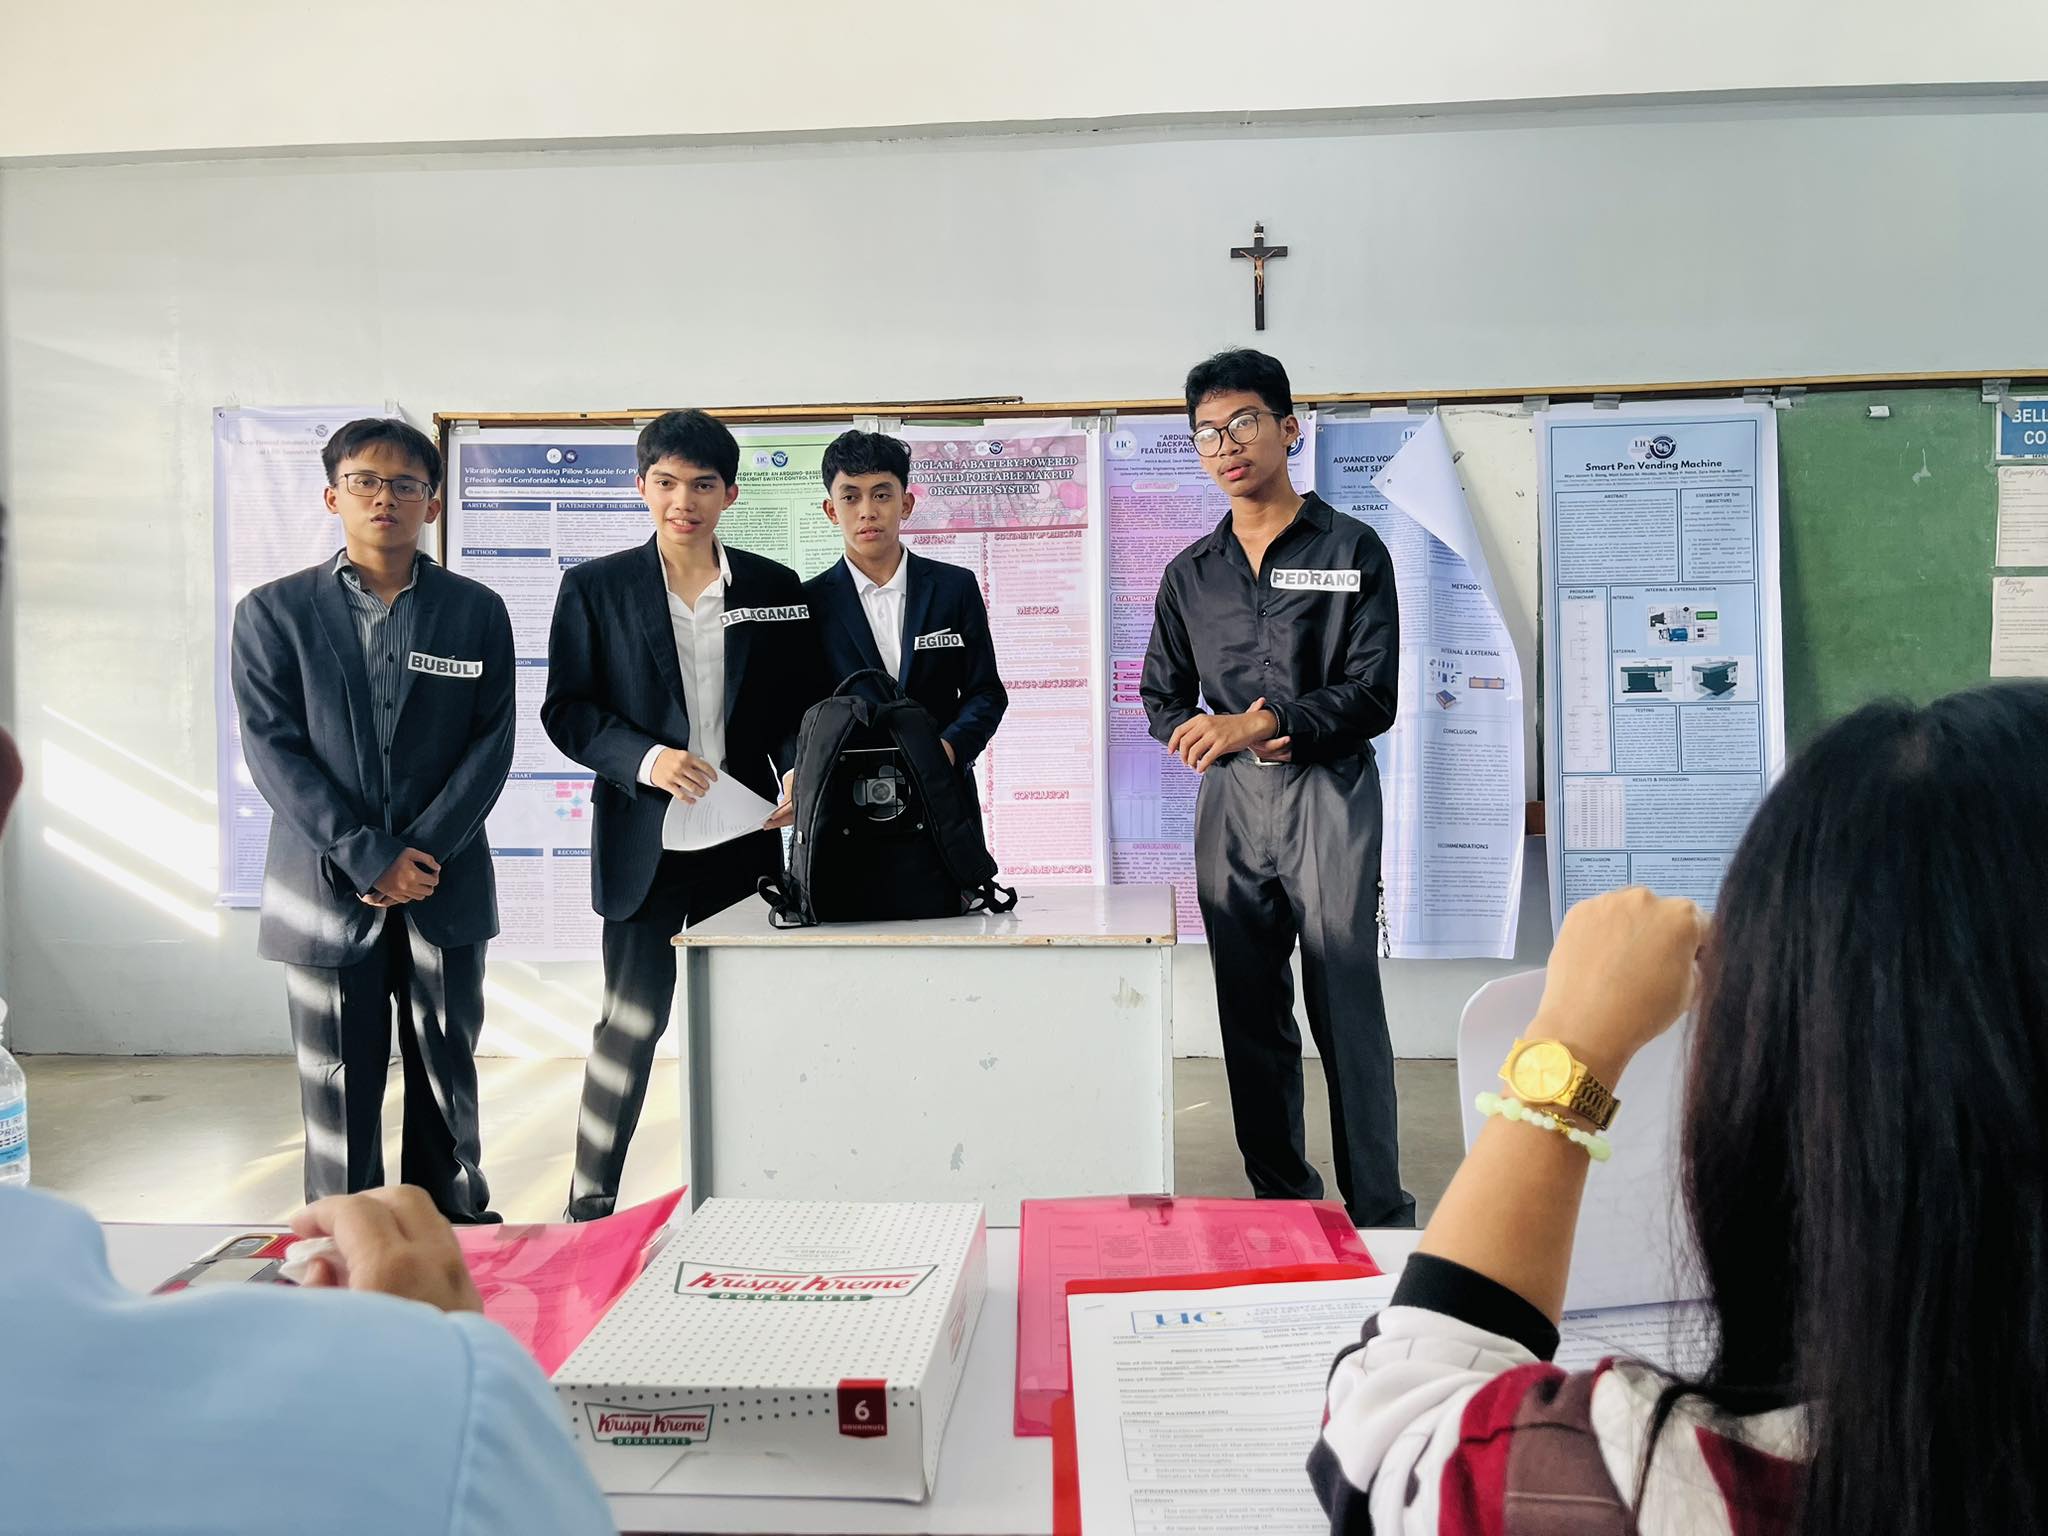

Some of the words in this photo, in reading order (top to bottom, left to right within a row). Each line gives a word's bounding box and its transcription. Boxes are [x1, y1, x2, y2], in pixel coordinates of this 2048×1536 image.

[969, 456, 1078, 469] BATTERY-POWERED
[1333, 455, 1376, 463] ADVANCED
[1585, 462, 1615, 471] Smart
[1617, 462, 1635, 470] Pen
[1637, 461, 1678, 471] Vending
[1681, 459, 1722, 469] Machine
[464, 466, 526, 476] VibratingArduino
[527, 466, 560, 476] Vibrating
[562, 466, 584, 475] Pillow
[585, 467, 615, 475] Suitable
[616, 467, 626, 475] for
[1343, 465, 1369, 473] SMART
[464, 476, 497, 484] Effective
[497, 476, 512, 484] and
[513, 476, 558, 484] Comfortable
[560, 477, 593, 486] Wake-Up
[594, 477, 607, 485] Aid
[908, 472, 964, 484] TOMATED
[965, 471, 1025, 482] PORTABLE
[1026, 469, 1074, 481] MAKEUP
[929, 485, 996, 496] ORGANIZER
[997, 483, 1040, 495] SYSTEM
[1272, 571, 1359, 586] PEDRANO
[917, 635, 960, 648] EGIDO
[411, 655, 480, 675] BUBULI
[1112, 672, 1118, 680] 2
[1112, 683, 1118, 691] 3
[1112, 694, 1118, 702] 4
[687, 1271, 805, 1293] Krispy
[802, 1274, 917, 1292] Kreme
[718, 1292, 863, 1301] DOUGHNUTS
[855, 1400, 870, 1420] 6
[597, 1412, 653, 1436] Krispy
[653, 1413, 707, 1433] Kreme
[616, 1437, 687, 1446] DOUGHNUTS
